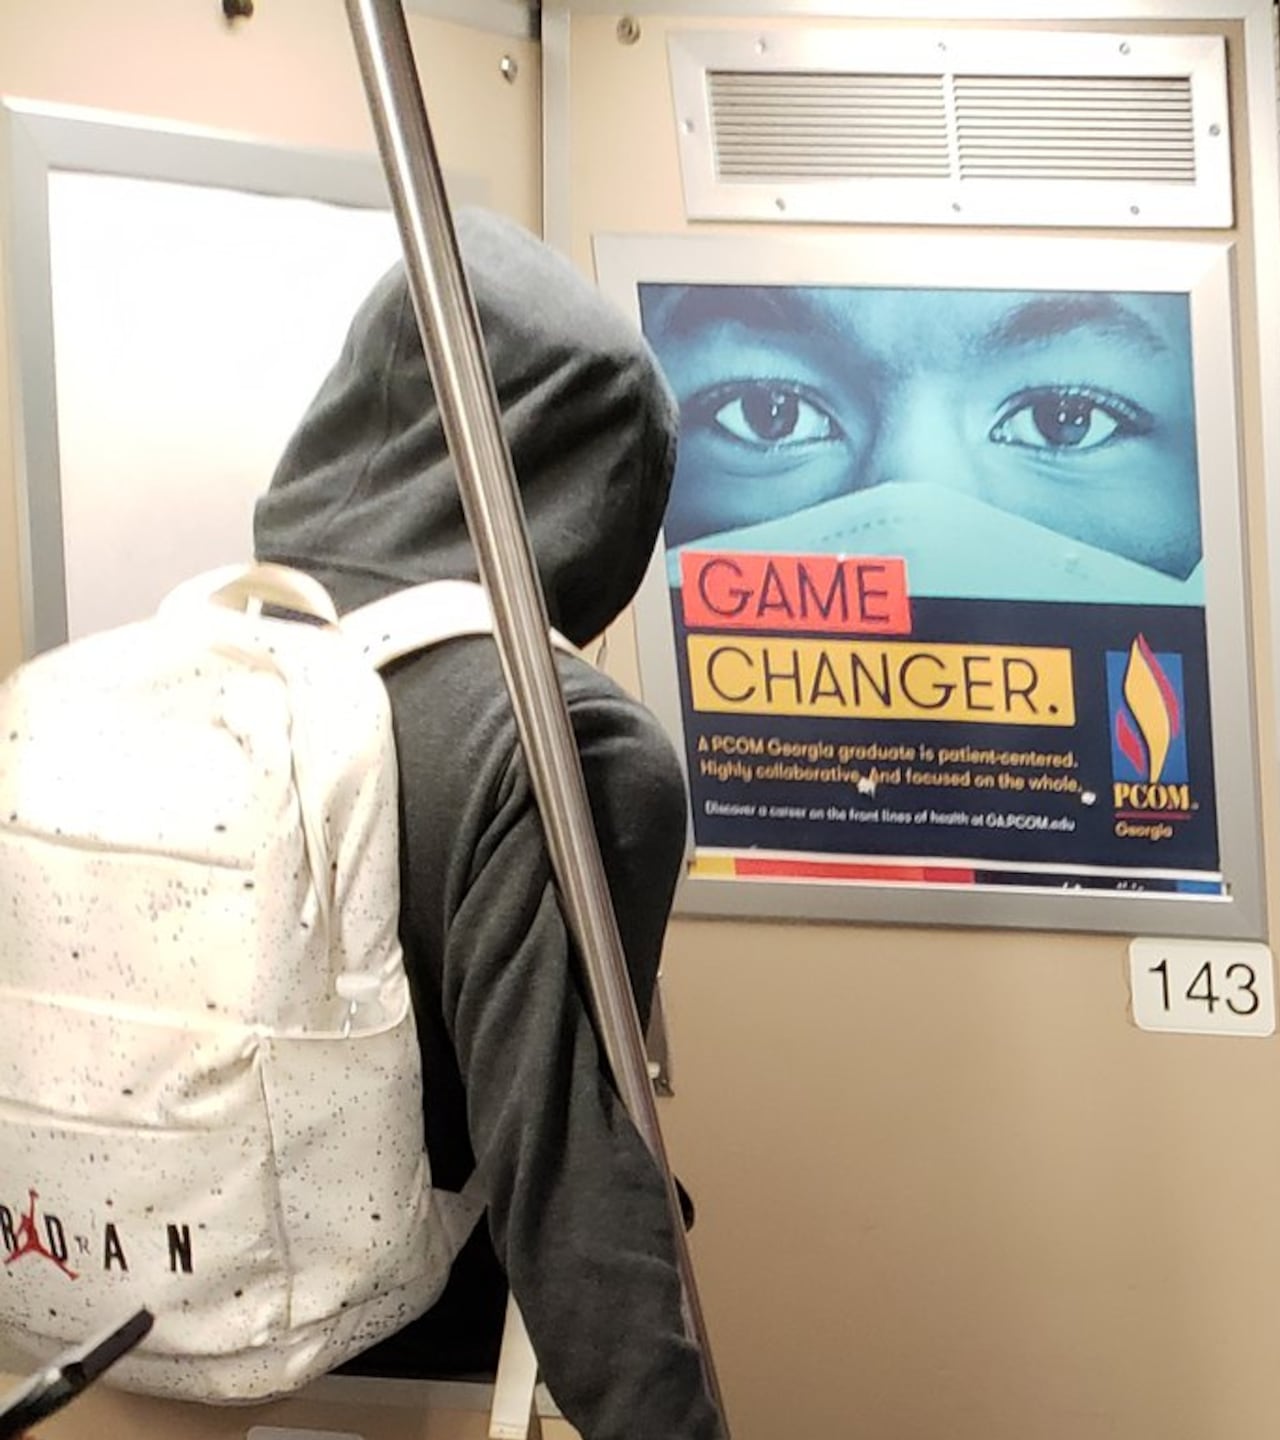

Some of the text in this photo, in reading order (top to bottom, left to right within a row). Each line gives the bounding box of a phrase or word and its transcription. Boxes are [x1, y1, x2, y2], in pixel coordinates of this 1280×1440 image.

[698, 558, 889, 623] GAME
[706, 647, 1059, 714] CHANGER.
[698, 734, 1079, 769] A PCOM Georgia graduate is patient-centered.
[700, 758, 752, 783] Highly
[868, 766, 901, 786] And
[905, 766, 971, 788] focused
[974, 774, 994, 788] on
[998, 772, 1025, 791] the
[704, 799, 756, 817] Discover
[769, 805, 807, 818] career
[809, 808, 825, 820] on
[826, 804, 847, 821] the
[848, 805, 879, 822] front
[882, 809, 912, 824] lines
[914, 809, 928, 823] of
[930, 809, 969, 826] health
[971, 813, 984, 826] at
[1113, 782, 1190, 811] PCOM
[1114, 821, 1174, 841] Georgia
[1149, 957, 1260, 1016] 143
